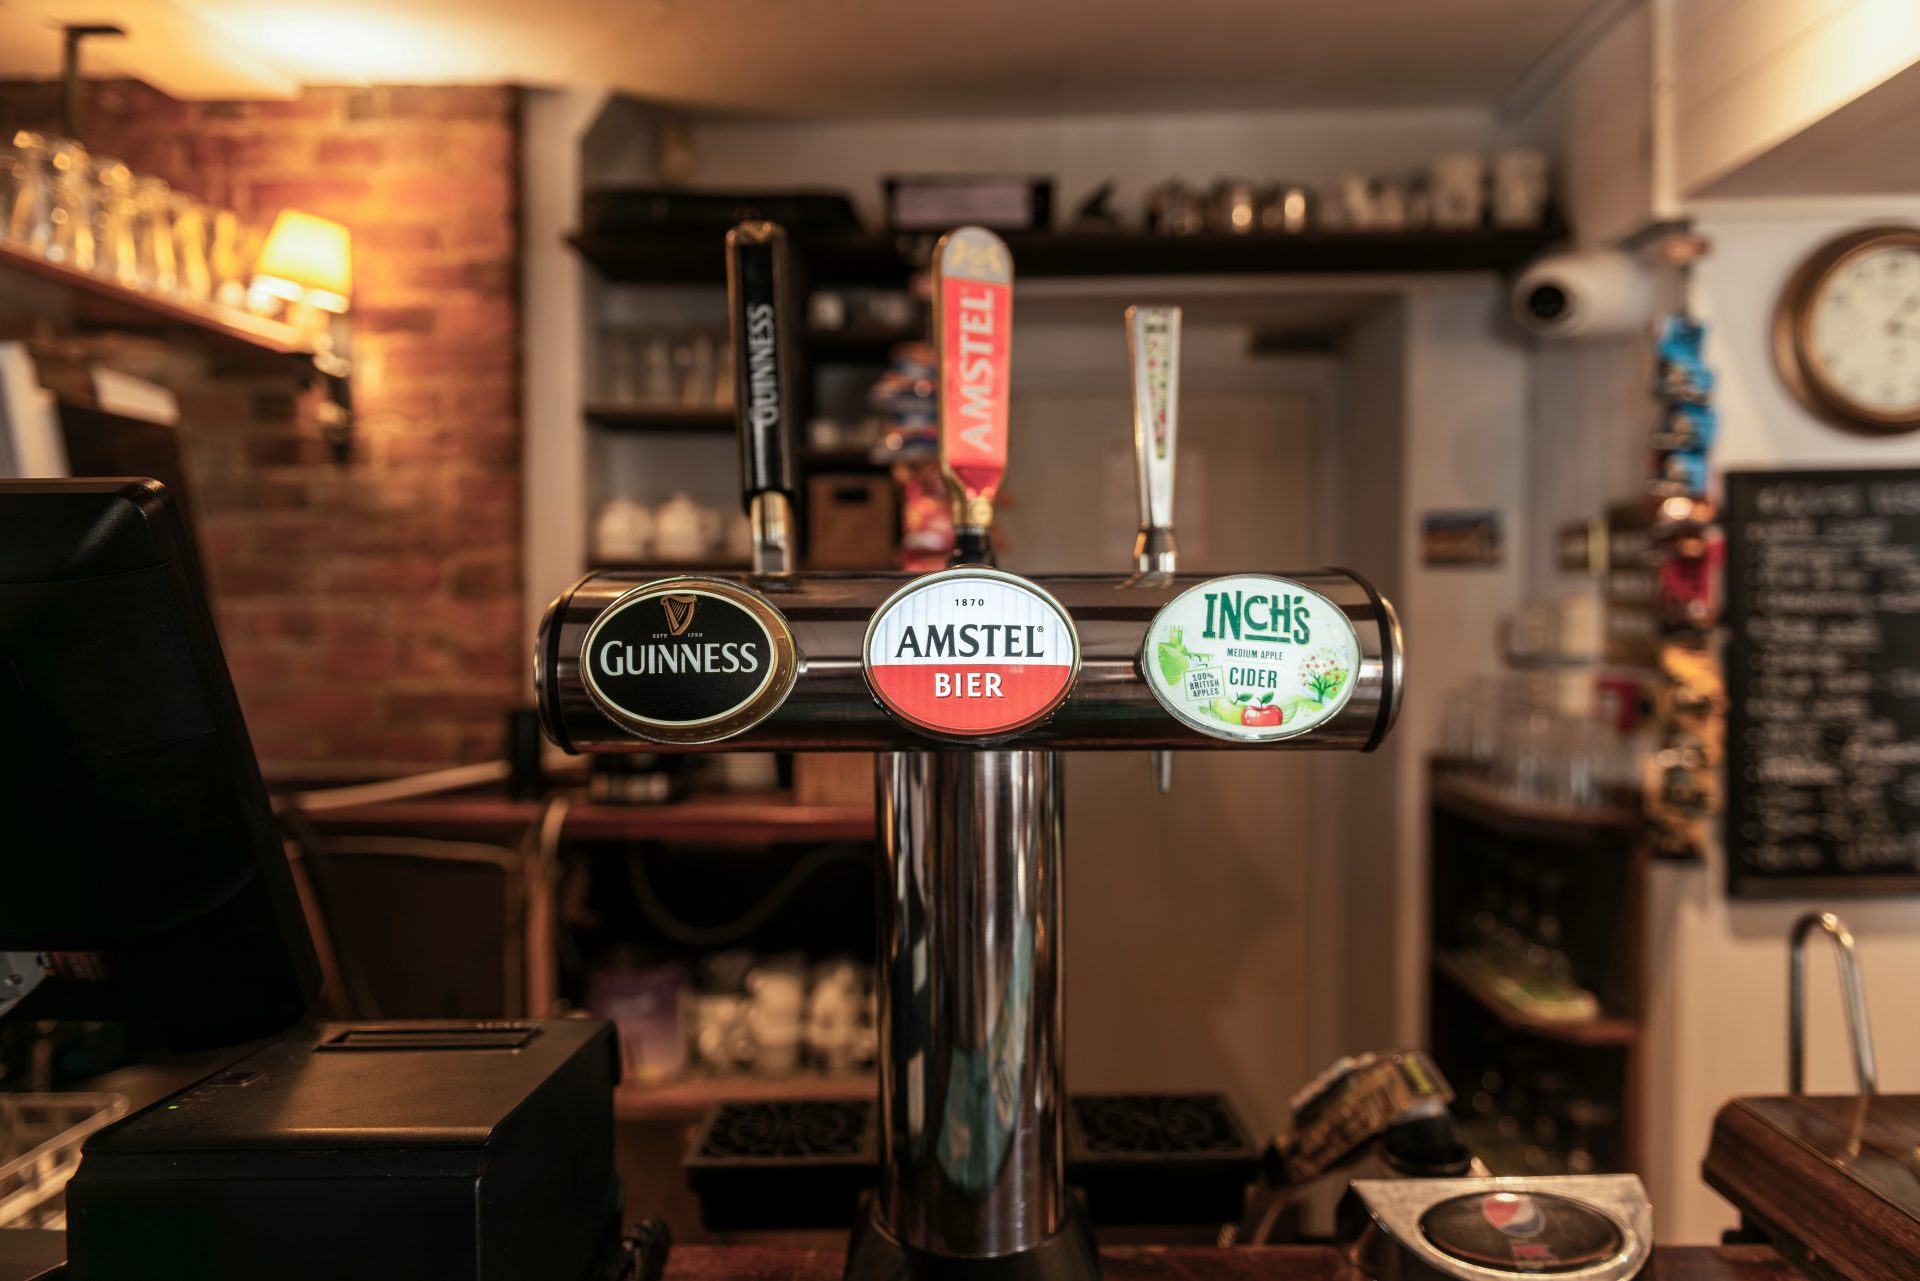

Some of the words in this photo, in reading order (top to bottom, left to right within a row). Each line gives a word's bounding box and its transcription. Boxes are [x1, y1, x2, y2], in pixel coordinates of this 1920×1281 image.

[959, 287, 994, 454] AMSTEL
[955, 599, 985, 607] 1870
[600, 640, 759, 677] GUINNESS
[1226, 647, 1258, 659] MEDIUM
[1260, 650, 1284, 661] APPLE
[1191, 672, 1214, 682] 100%
[1229, 666, 1278, 689] CIDER
[935, 672, 1005, 699] BIER
[1190, 679, 1220, 690] BRITISH
[1192, 688, 1220, 698] APPLES
